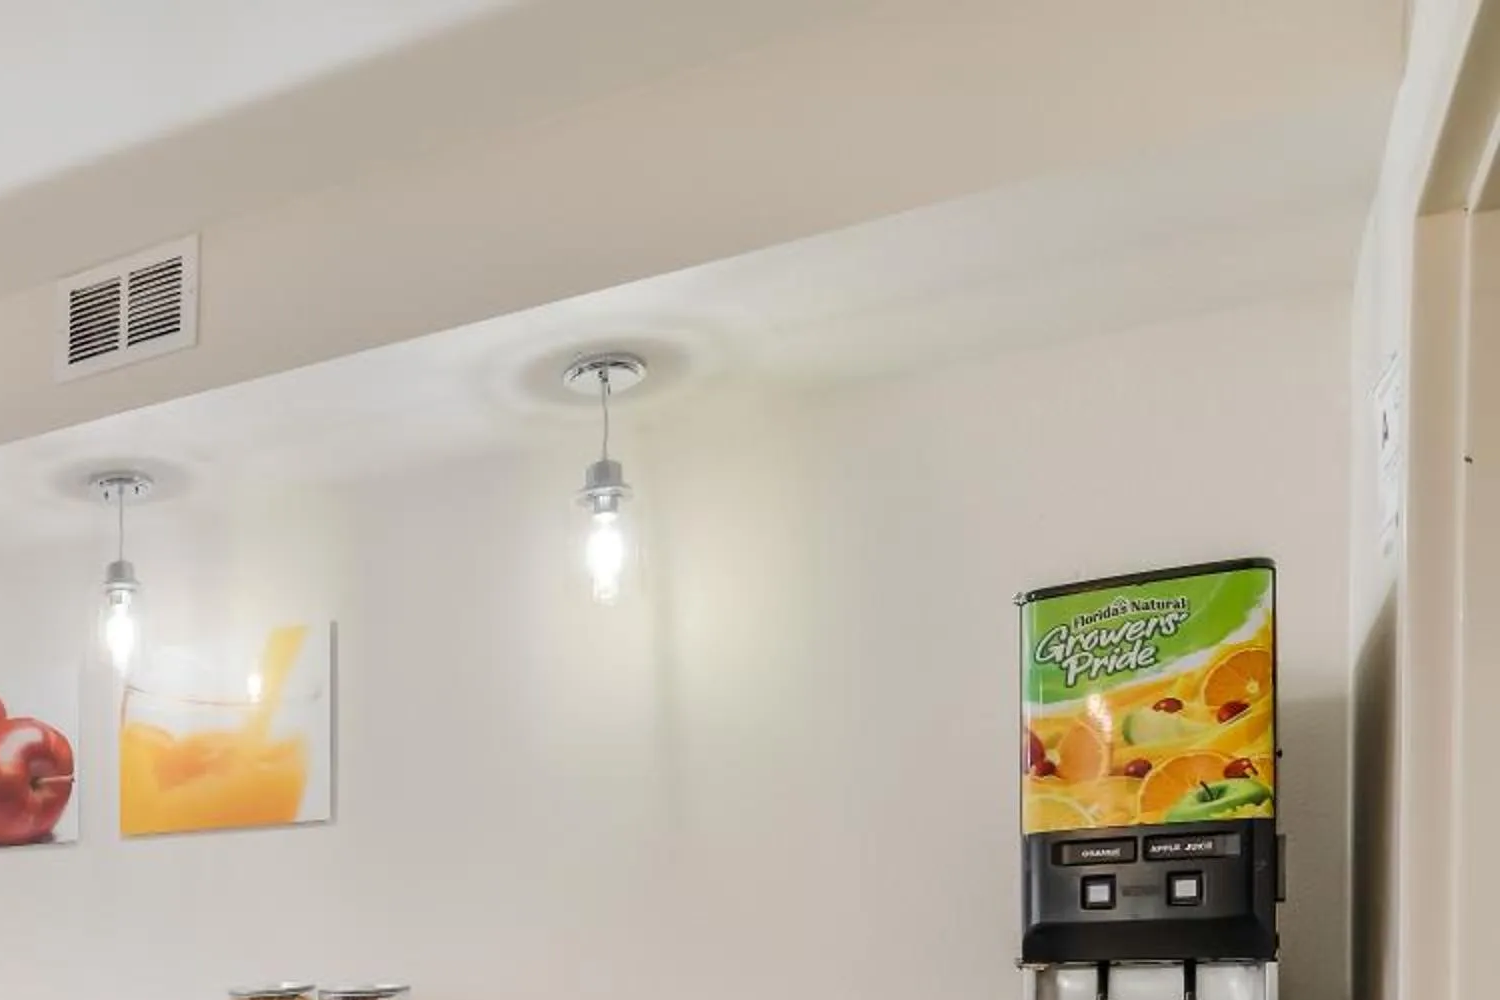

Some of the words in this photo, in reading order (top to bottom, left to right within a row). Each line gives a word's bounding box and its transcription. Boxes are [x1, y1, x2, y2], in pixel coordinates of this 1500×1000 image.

[1073, 602, 1128, 628] Florida's
[1131, 597, 1187, 613] Natural
[1061, 640, 1157, 686] Pride
